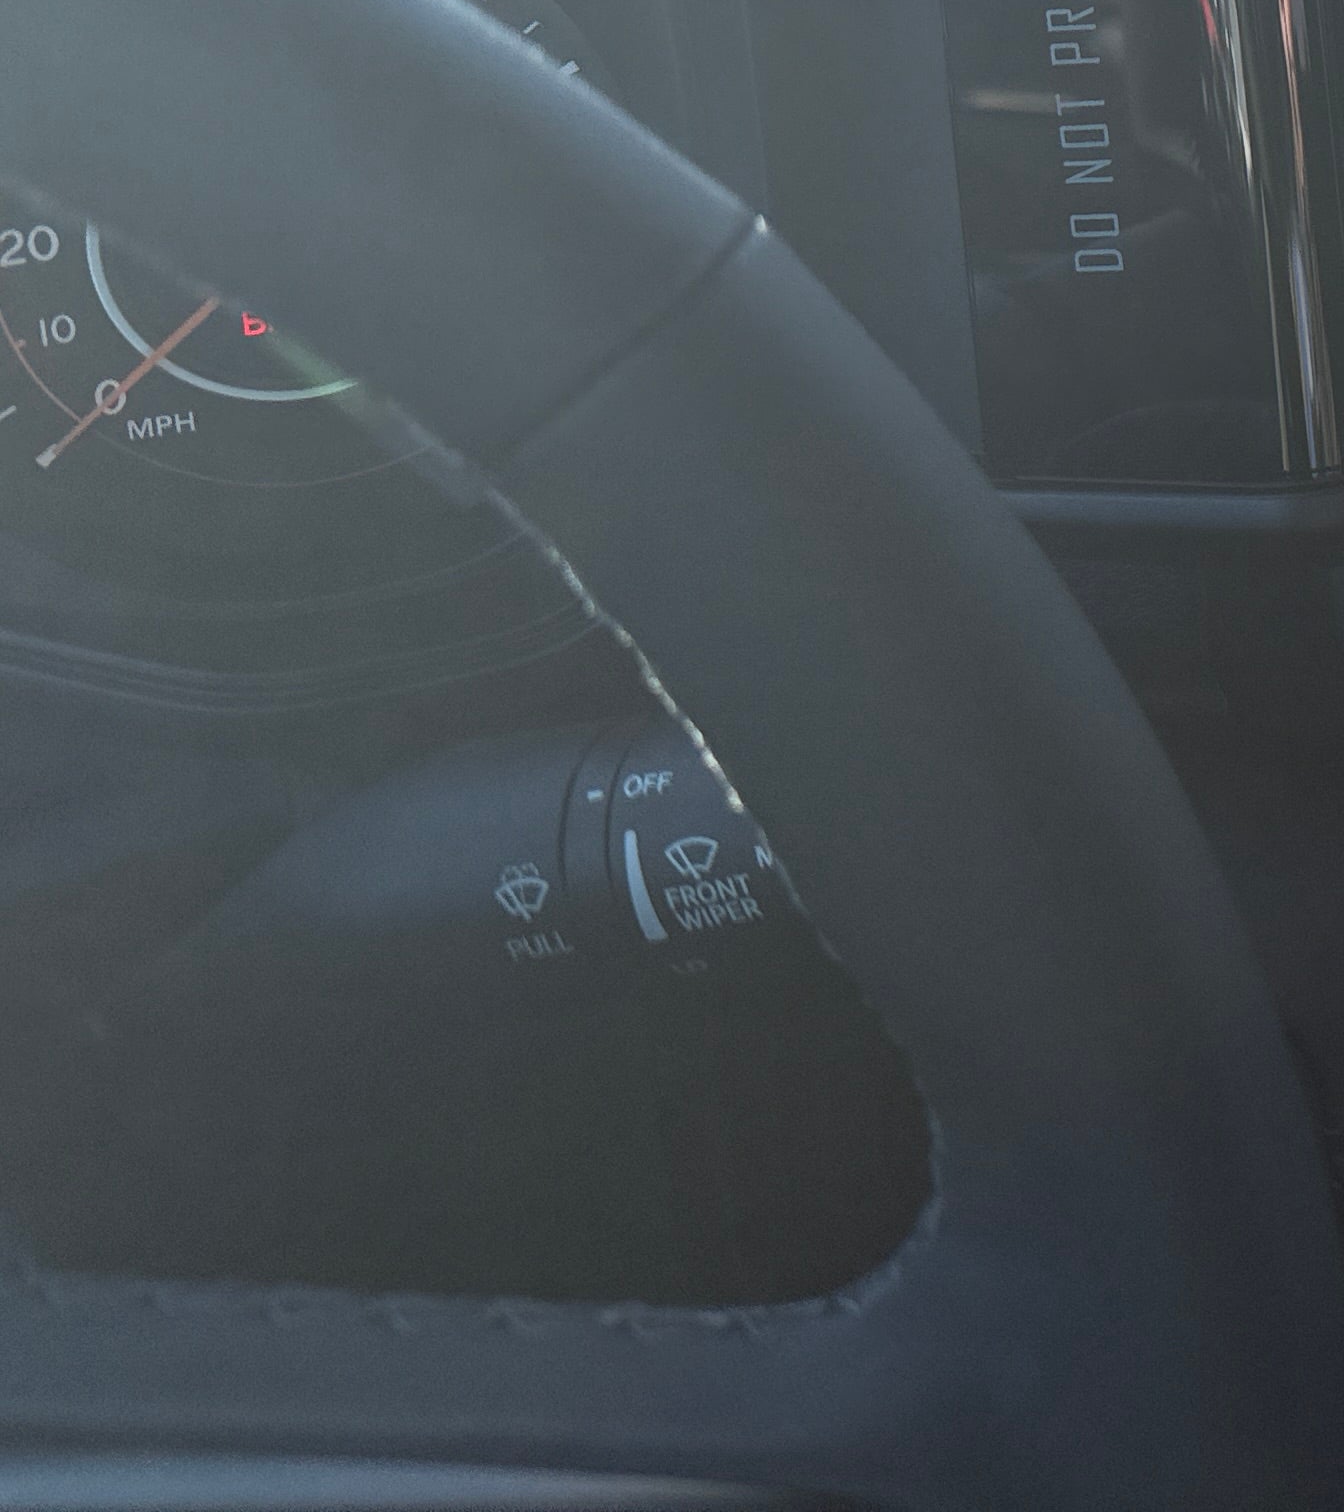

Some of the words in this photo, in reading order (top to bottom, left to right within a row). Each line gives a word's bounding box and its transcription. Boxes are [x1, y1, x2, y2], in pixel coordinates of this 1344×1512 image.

[1054, 92, 1115, 185] NOT
[0, 224, 60, 268] 20
[1069, 213, 1125, 274] DO
[39, 314, 77, 348] 10
[94, 378, 127, 416] 0
[126, 411, 196, 440] MPH
[623, 770, 674, 800] OFF
[663, 872, 750, 911] FRONT
[673, 897, 764, 933] WIPER
[505, 930, 576, 963] PULL
